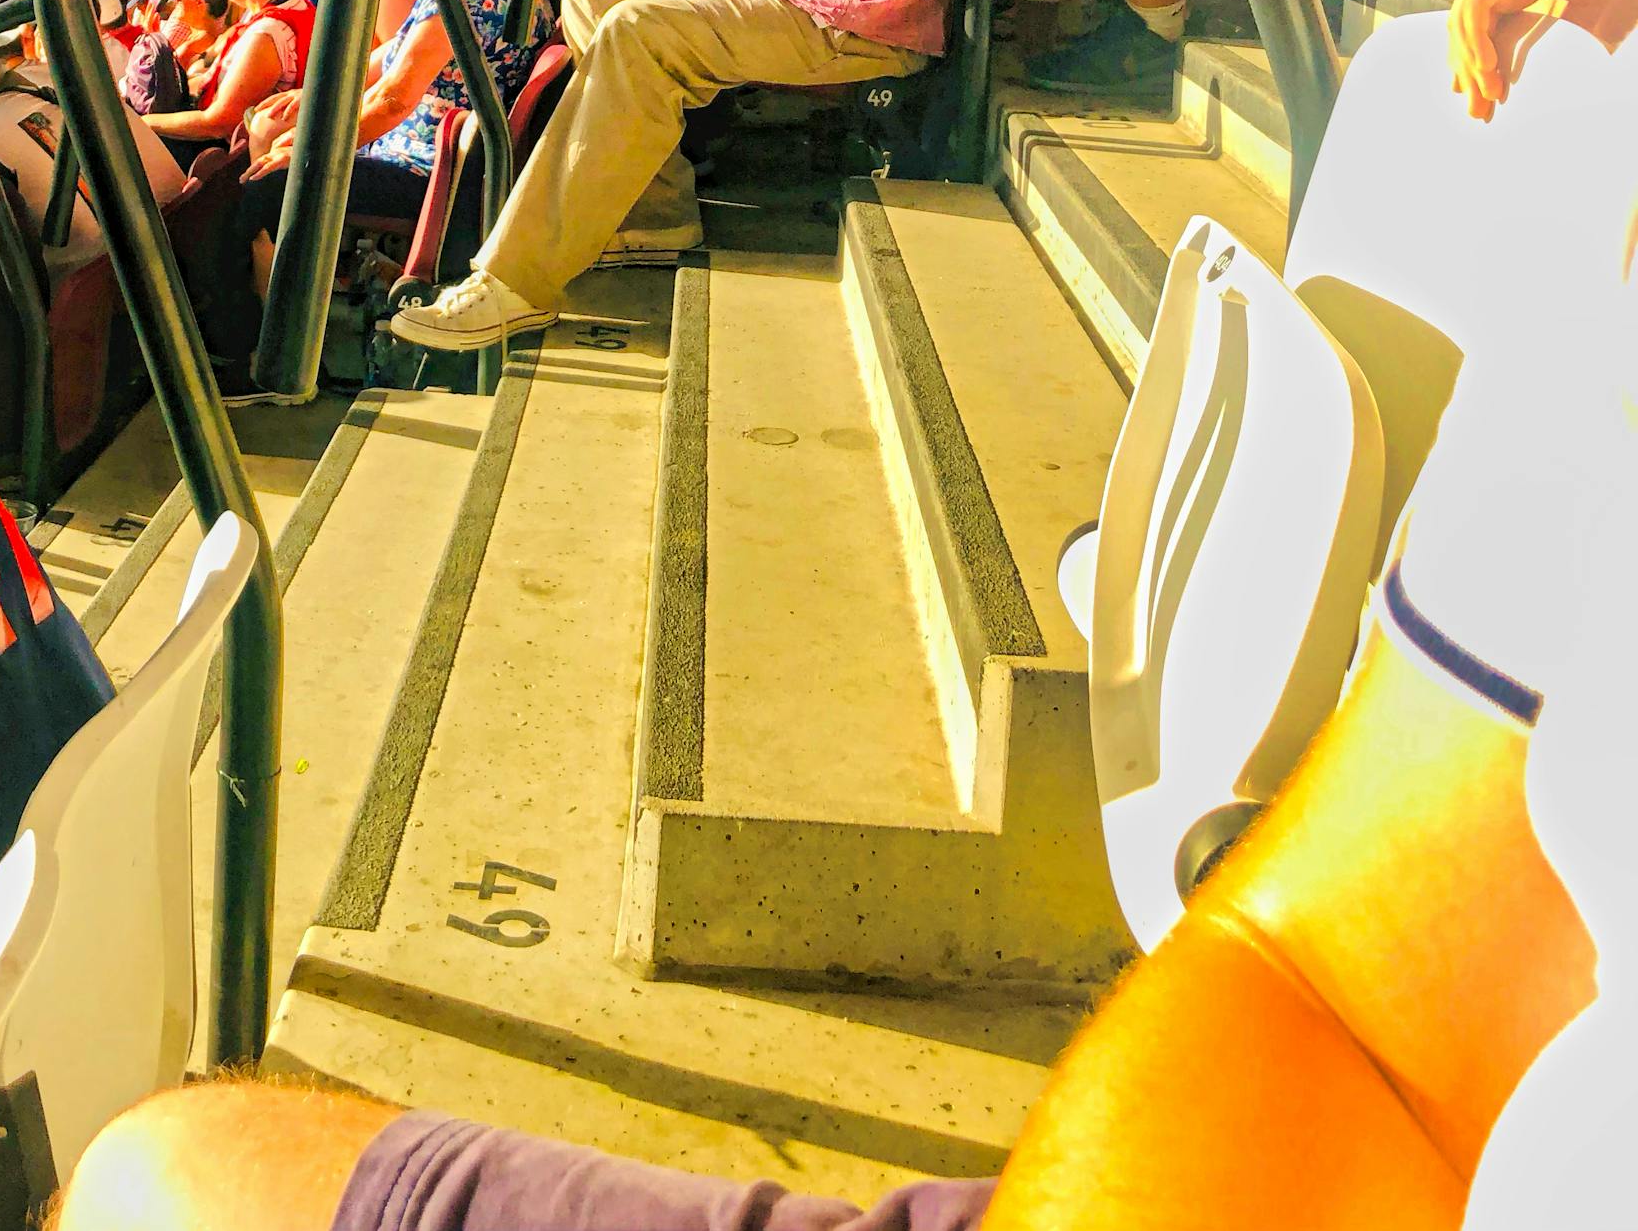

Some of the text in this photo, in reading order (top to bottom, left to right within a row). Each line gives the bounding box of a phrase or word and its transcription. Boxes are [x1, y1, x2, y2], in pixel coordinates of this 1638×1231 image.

[867, 88, 893, 107] 49
[397, 295, 423, 310] 48
[446, 860, 557, 948] 49
